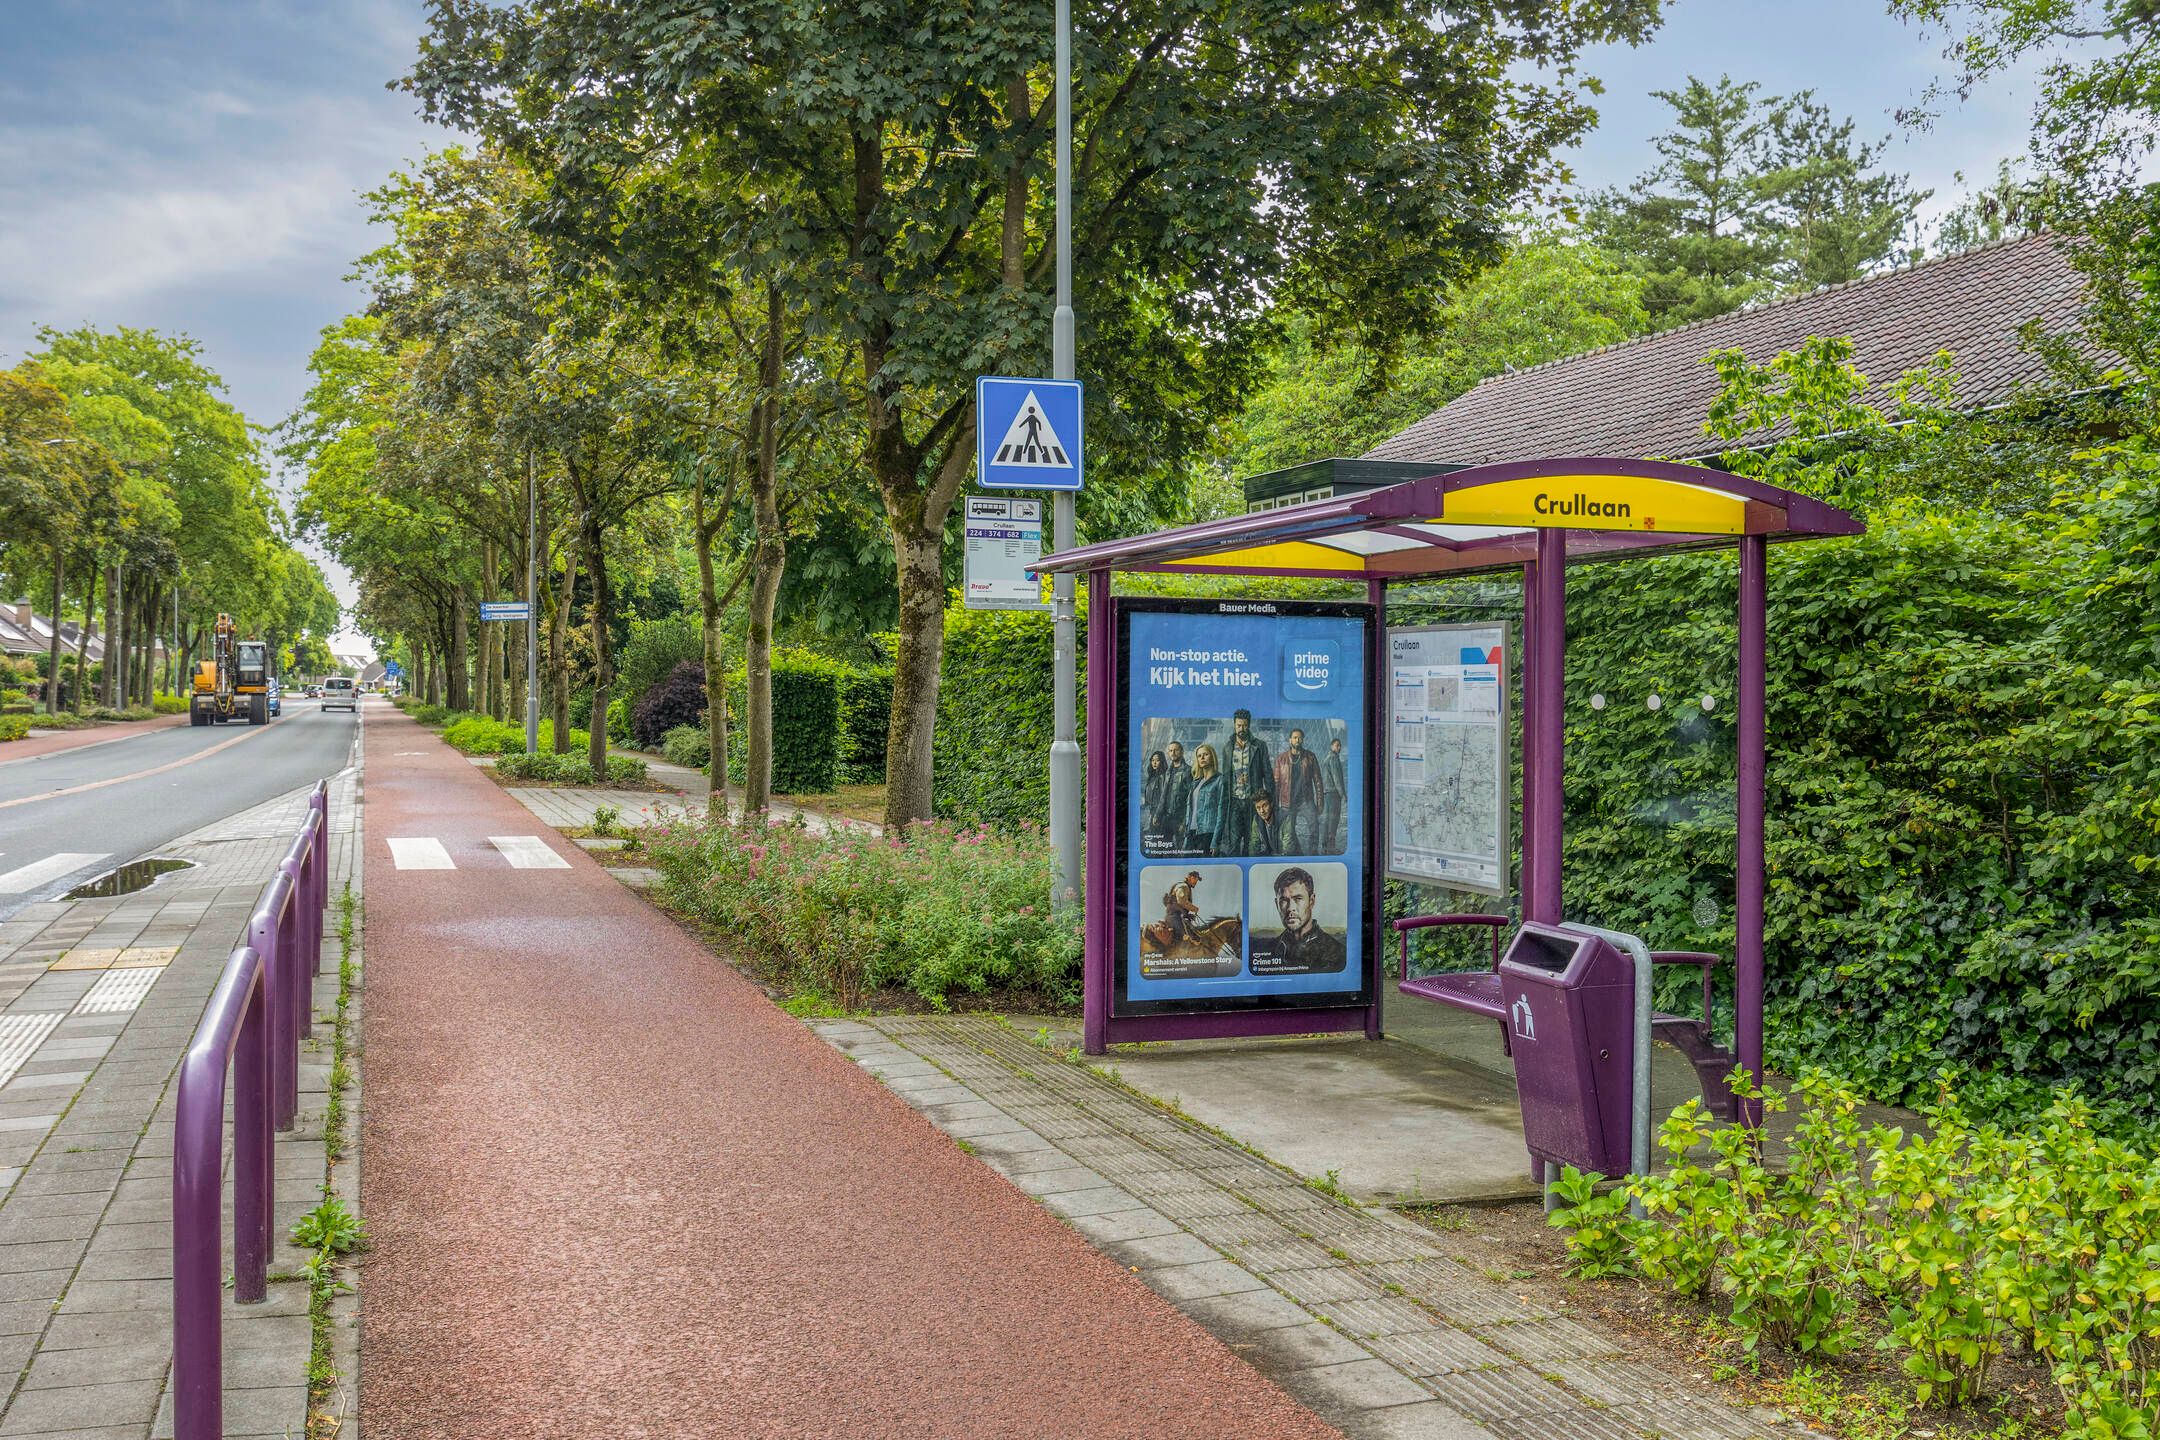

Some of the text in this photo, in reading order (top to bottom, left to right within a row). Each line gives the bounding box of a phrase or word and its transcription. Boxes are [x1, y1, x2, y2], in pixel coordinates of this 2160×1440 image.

[1534, 493, 1631, 518] Crullaan
[969, 529, 983, 537] 224
[1219, 603, 1277, 613] Bauer Media
[1393, 640, 1420, 650] Crullaan
[1150, 647, 1249, 664] Non-stop actie.
[1294, 651, 1330, 666] prime
[1150, 666, 1263, 689] Kijk het hier.
[1294, 666, 1329, 679] video
[1144, 840, 1173, 849] The Boys
[1180, 957, 1215, 965] Yellowstone
[1215, 956, 1233, 964] Story
[1252, 957, 1282, 966] Crime 101
